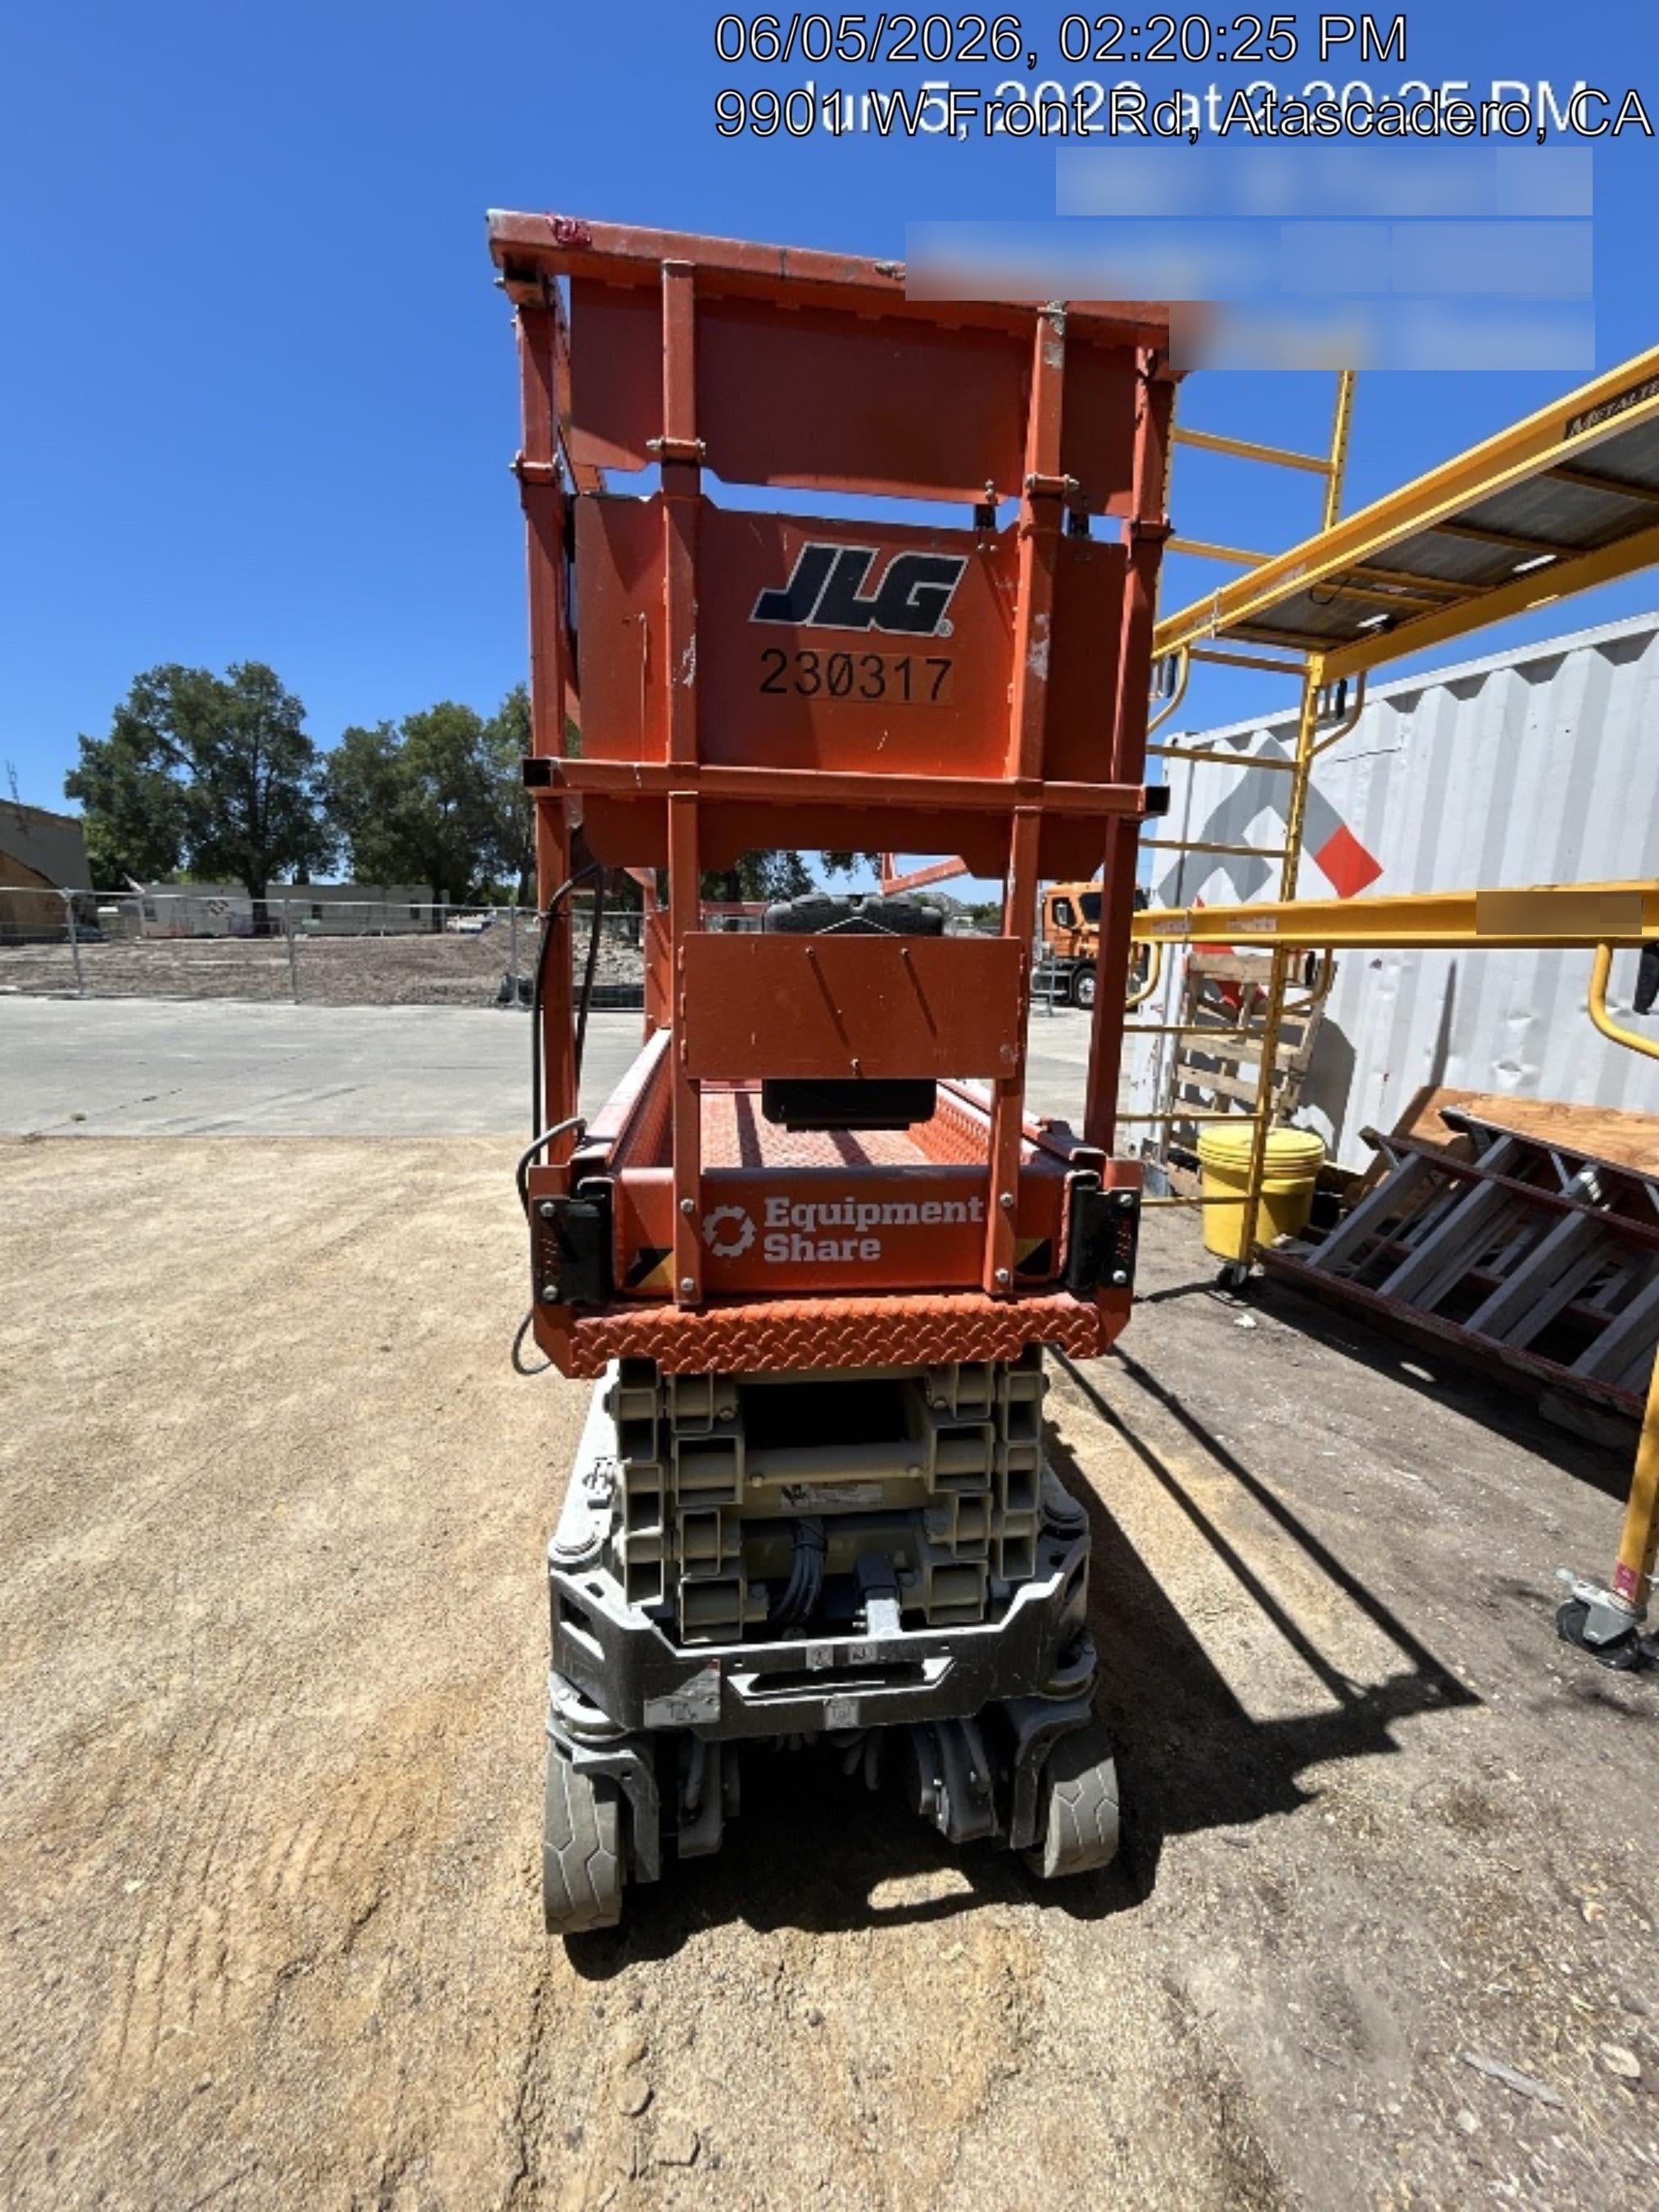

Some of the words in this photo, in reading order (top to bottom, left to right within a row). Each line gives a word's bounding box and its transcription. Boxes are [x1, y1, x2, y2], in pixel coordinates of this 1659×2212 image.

[749, 542, 969, 636] JLG
[759, 649, 952, 700] 230317
[764, 1195, 983, 1232] Equipment
[764, 1234, 881, 1262] Share
